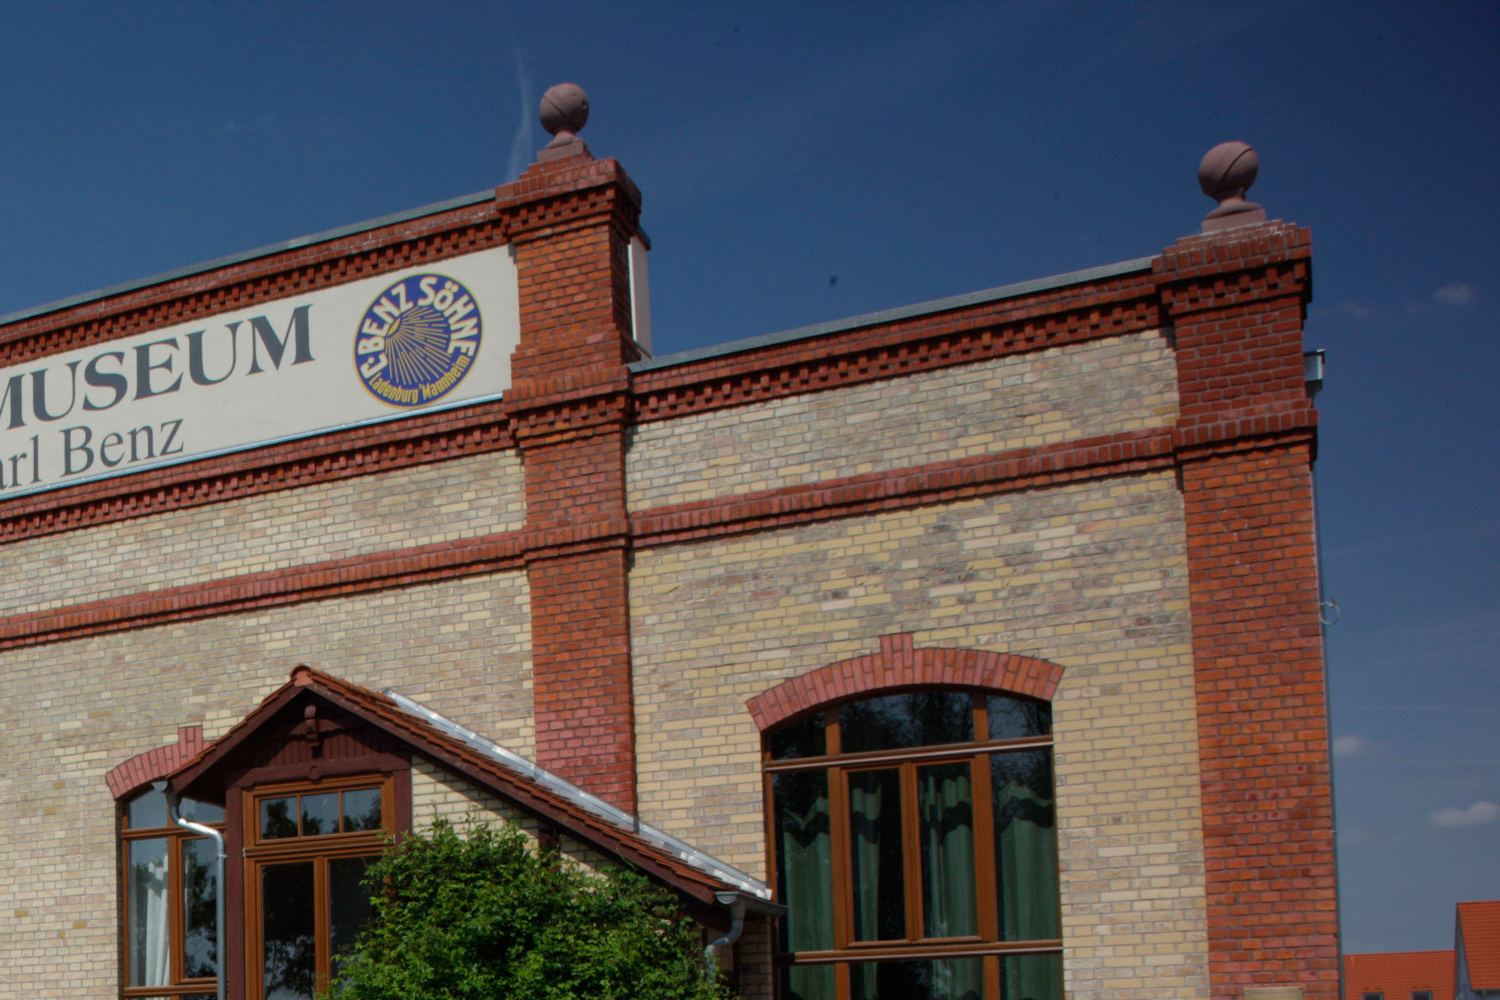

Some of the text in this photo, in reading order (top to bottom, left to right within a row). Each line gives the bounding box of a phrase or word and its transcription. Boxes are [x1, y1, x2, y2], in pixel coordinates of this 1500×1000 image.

[368, 354, 471, 405] Ladenburg Mannheim
[58, 417, 184, 478] Benz
